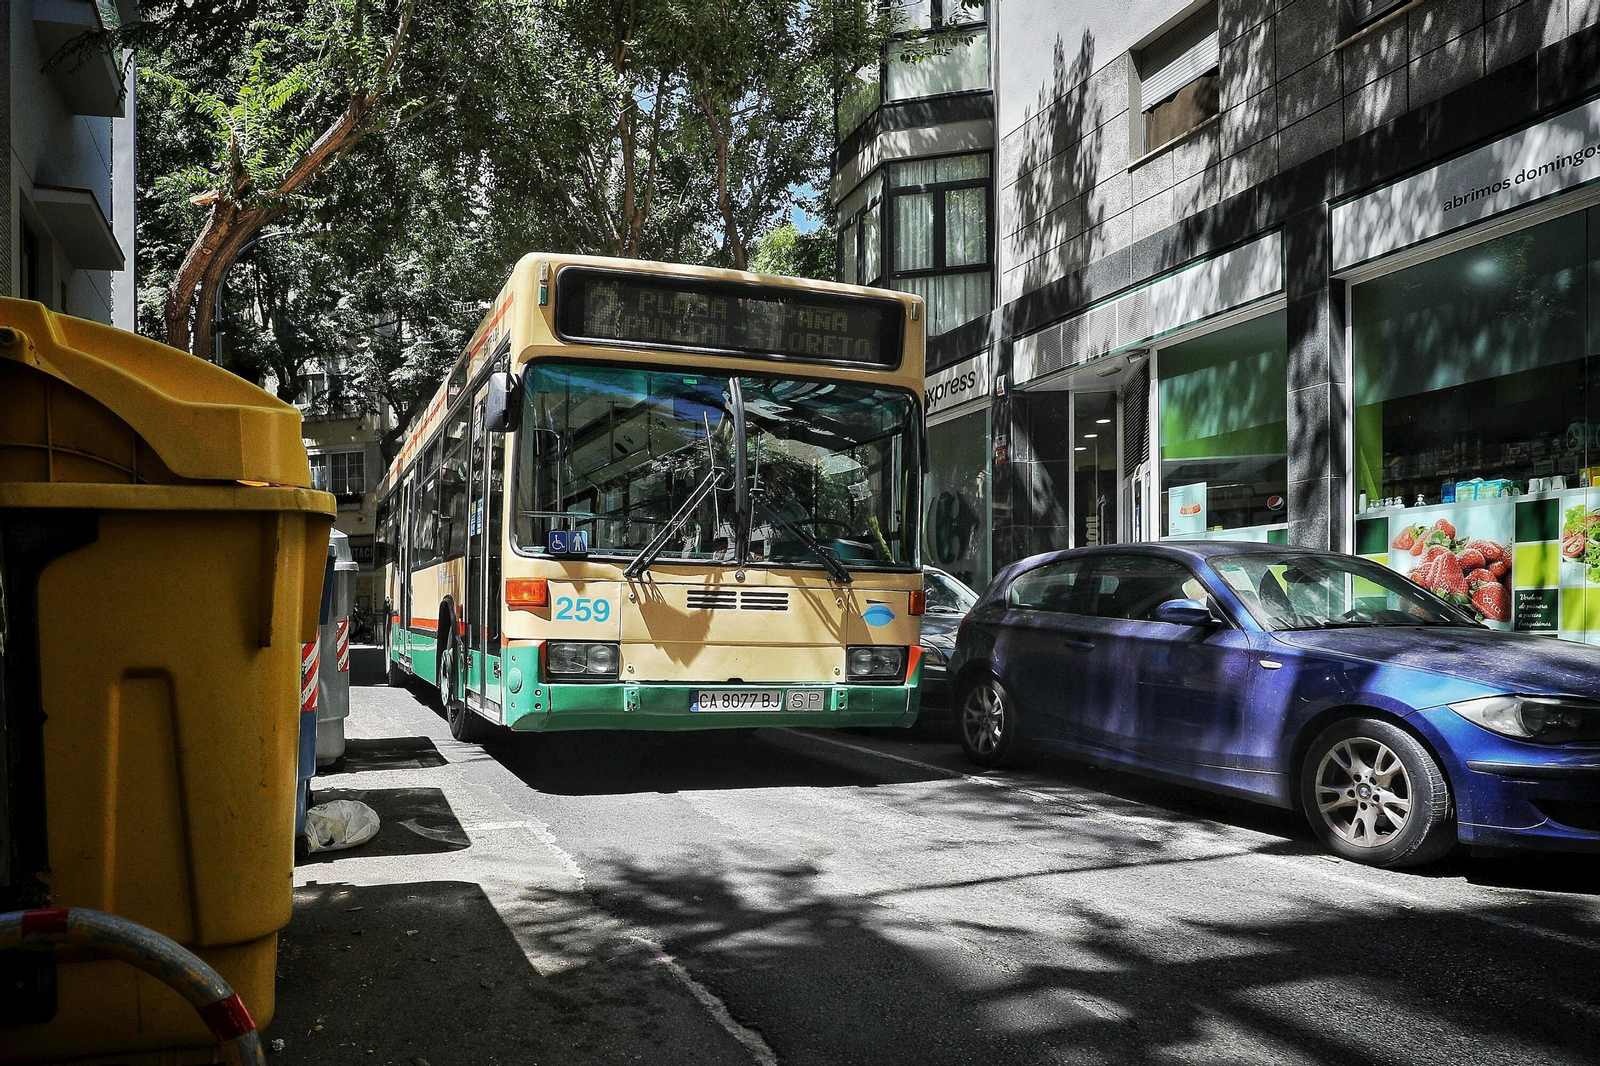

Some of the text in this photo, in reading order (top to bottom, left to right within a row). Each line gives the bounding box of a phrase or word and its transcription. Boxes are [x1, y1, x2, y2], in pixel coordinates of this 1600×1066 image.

[1443, 143, 1600, 211] abrimos domingos
[639, 290, 728, 319] PLAZA
[556, 596, 610, 622] 259
[699, 693, 780, 709] CA 8077 BJ
[791, 693, 820, 709] SP
